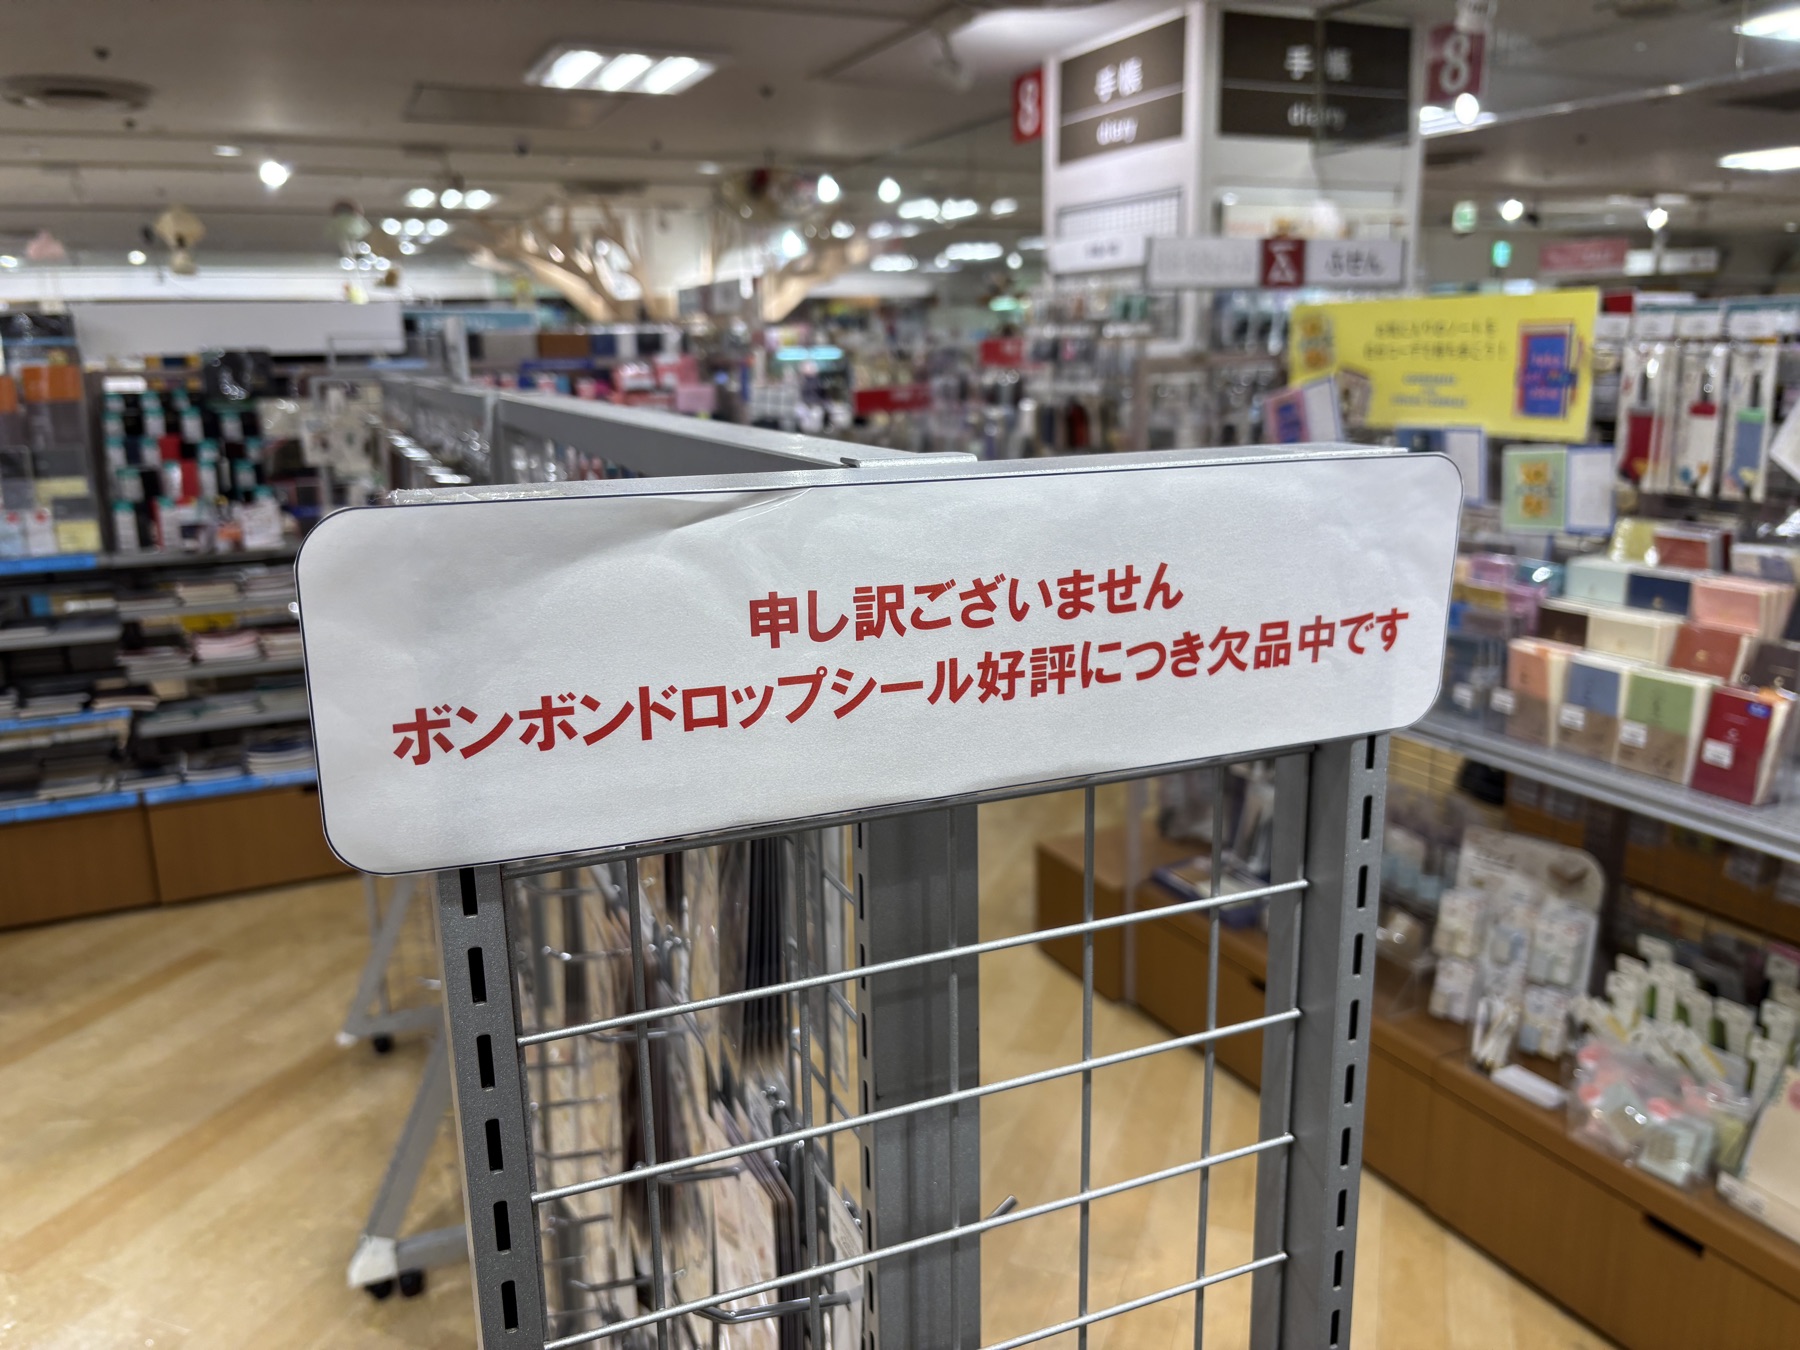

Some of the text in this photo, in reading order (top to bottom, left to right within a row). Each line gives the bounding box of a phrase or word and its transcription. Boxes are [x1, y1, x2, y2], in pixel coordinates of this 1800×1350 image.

[1440, 34, 1471, 93] 8
[1018, 78, 1040, 136] 8
[750, 563, 1183, 648] 申し訳ございません
[394, 608, 1409, 765] ボンボンドロップシール好評につき欠品中です
